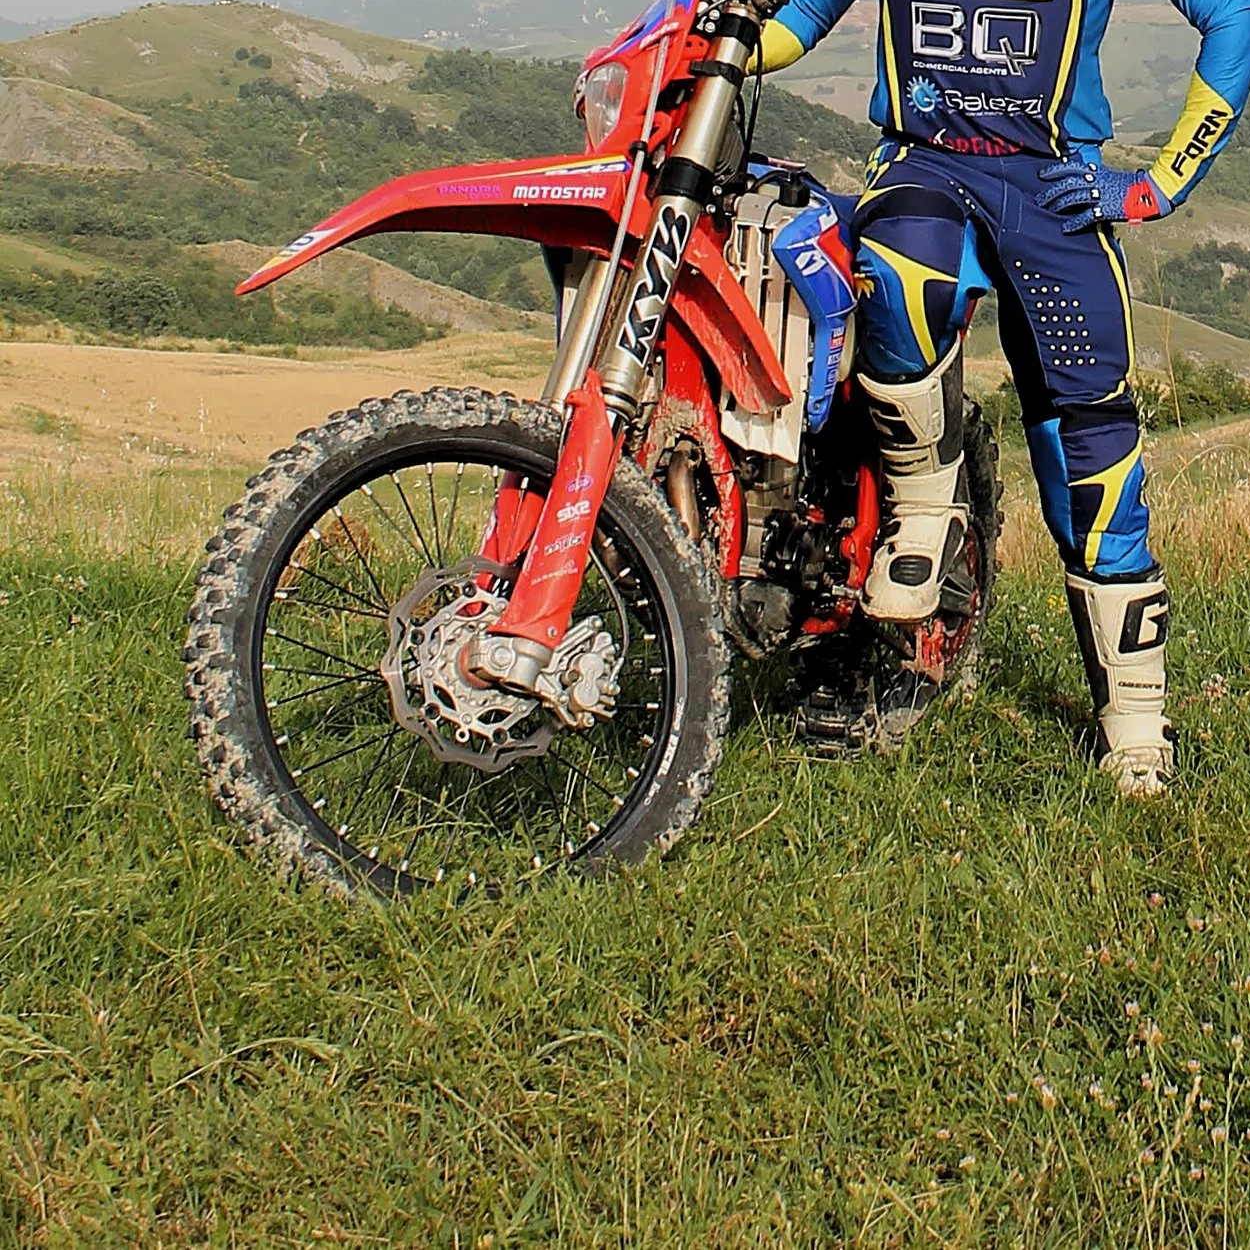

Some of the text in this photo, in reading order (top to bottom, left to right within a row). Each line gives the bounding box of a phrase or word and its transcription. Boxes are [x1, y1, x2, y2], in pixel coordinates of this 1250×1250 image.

[911, 1, 1041, 78] BQ
[912, 60, 1007, 76] COMMERCIAL AGENTS
[944, 89, 1044, 114] Galezzi
[1170, 109, 1228, 177] FORN
[513, 186, 606, 199] MOTOSTAR
[615, 205, 691, 368] KYB
